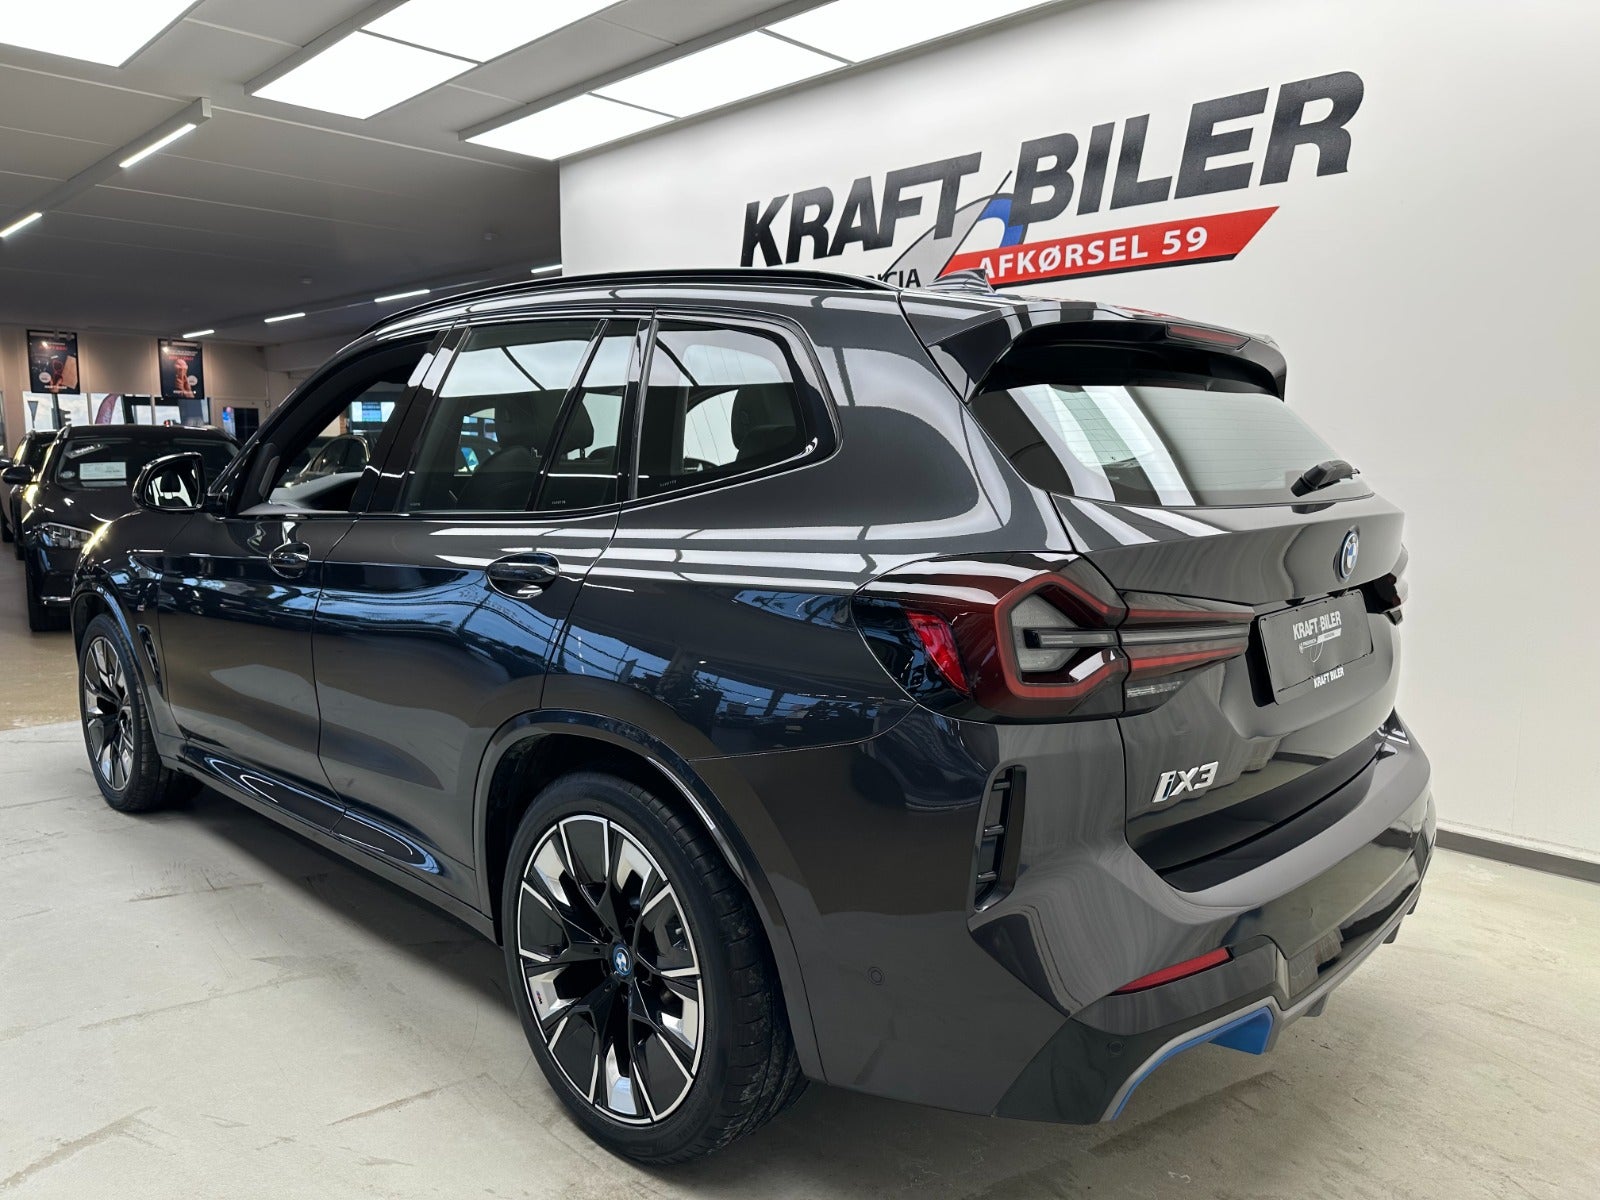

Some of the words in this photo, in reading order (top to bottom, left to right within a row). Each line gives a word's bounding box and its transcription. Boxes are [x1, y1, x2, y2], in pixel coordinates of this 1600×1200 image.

[740, 152, 982, 267] KRAFT
[1008, 70, 1365, 227] BILER
[979, 235, 1148, 279] AFKØRSEL
[1162, 227, 1208, 256] 59
[1292, 618, 1318, 640] KRAFT
[1320, 611, 1342, 631] BILER
[1313, 673, 1330, 688] KRAFT
[1330, 667, 1344, 681] BILER
[1152, 761, 1219, 803] iX3
